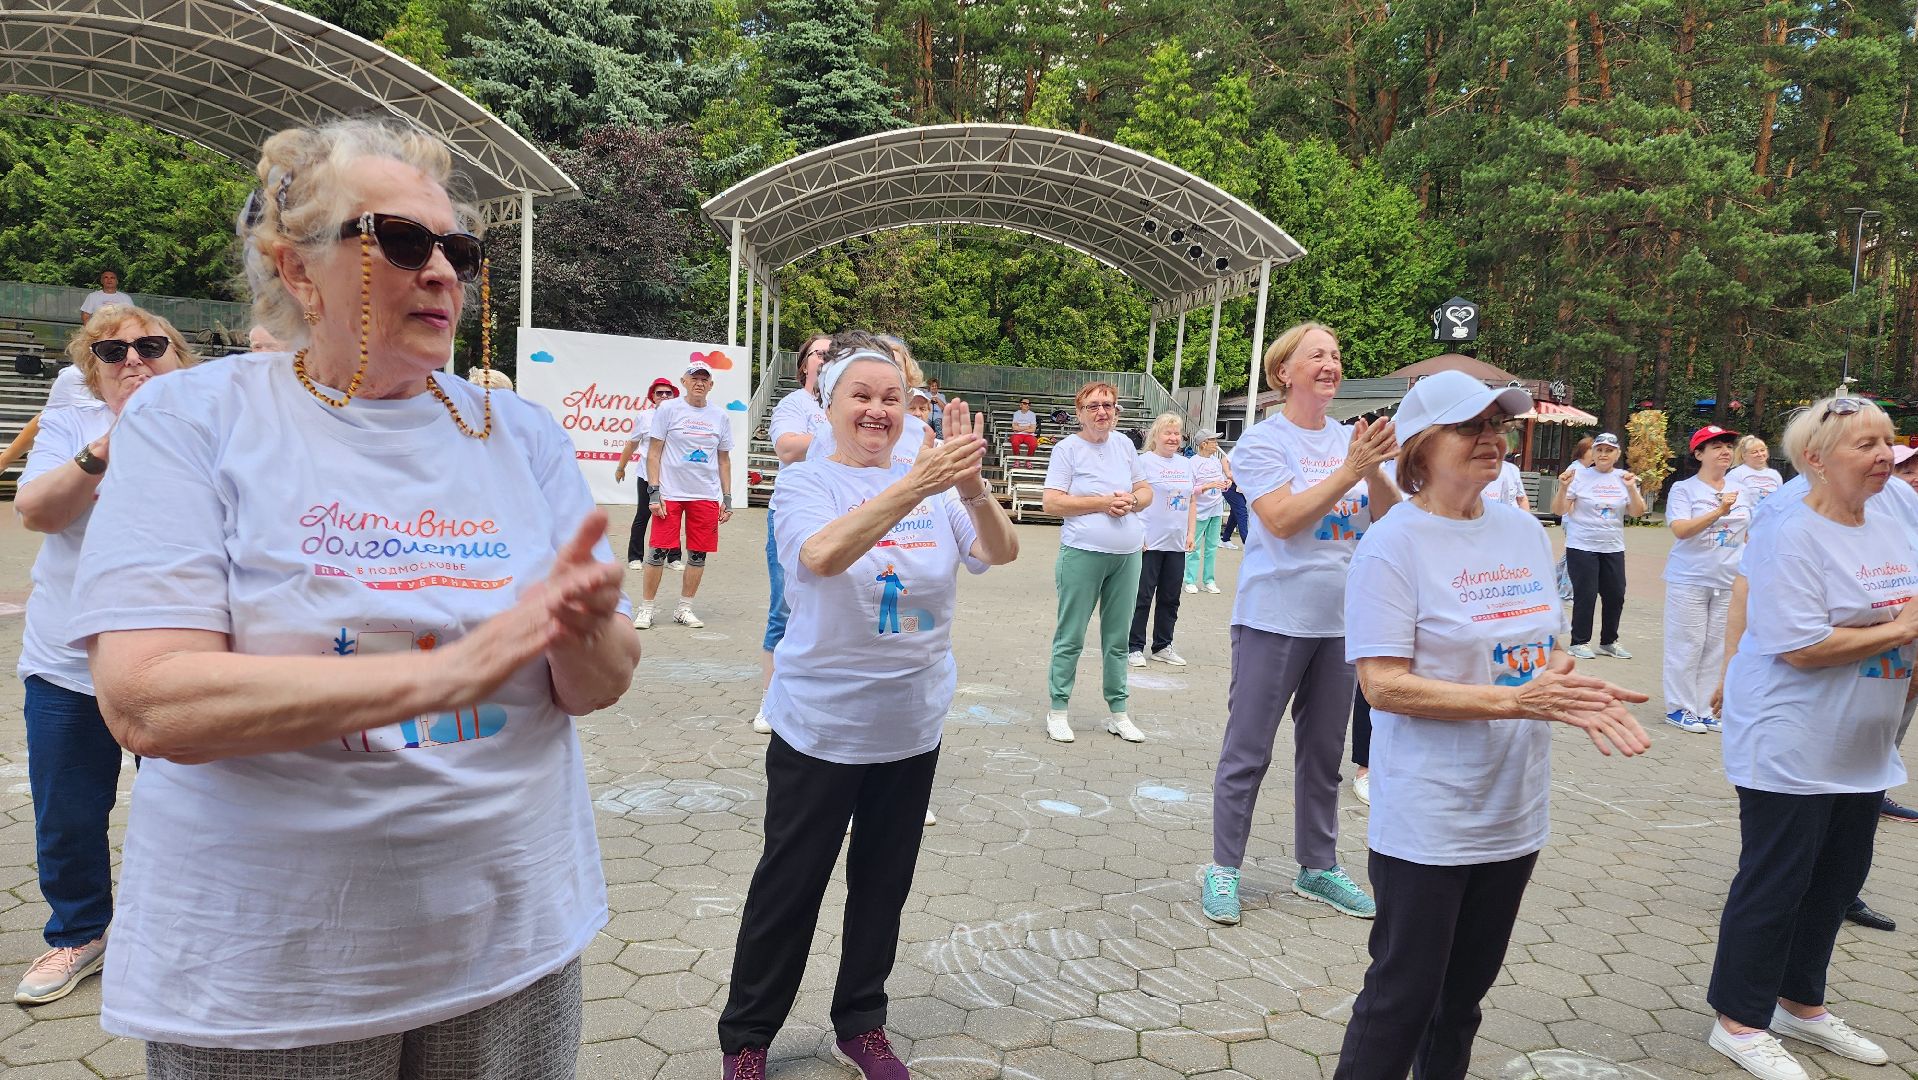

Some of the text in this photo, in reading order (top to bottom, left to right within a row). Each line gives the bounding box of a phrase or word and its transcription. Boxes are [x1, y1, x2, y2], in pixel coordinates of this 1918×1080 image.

[300, 502, 499, 537] Активное
[301, 523, 511, 560] долголетие
[368, 561, 467, 576] ПОДМОСКОВЬЕ
[1452, 563, 1533, 589] Активное
[1459, 580, 1544, 603] долголетие
